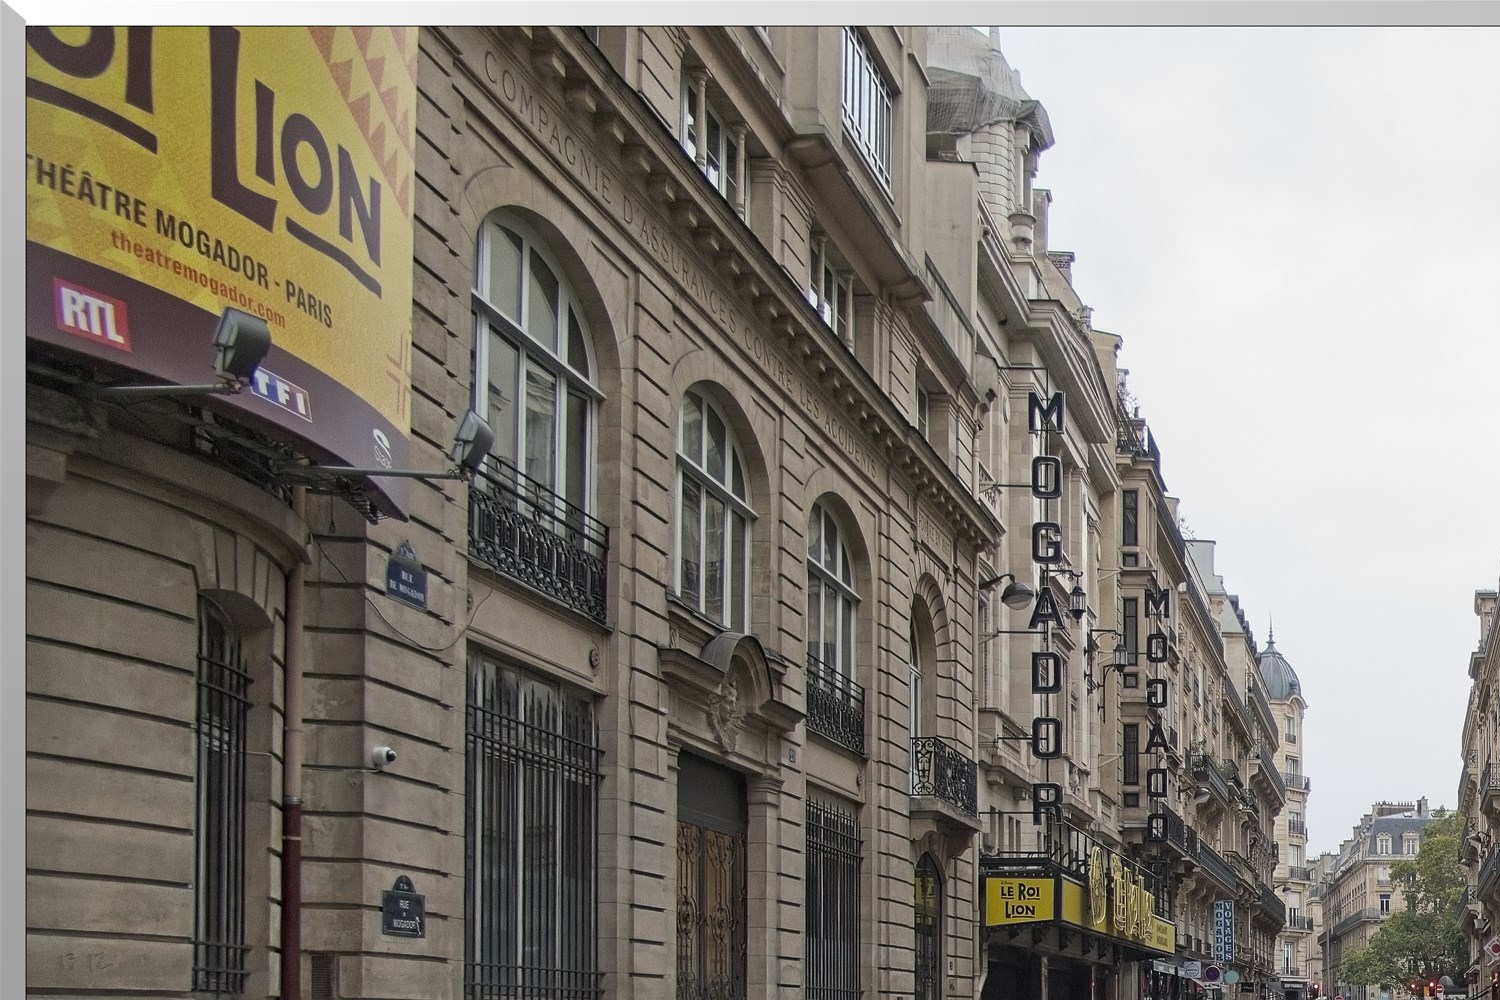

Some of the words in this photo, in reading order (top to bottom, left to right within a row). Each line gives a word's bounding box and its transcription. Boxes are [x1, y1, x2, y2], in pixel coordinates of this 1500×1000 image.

[209, 26, 382, 268] LION
[110, 230, 286, 329] theatremogador.com
[156, 207, 269, 290] MOGADOR
[286, 278, 332, 329] PARIS
[484, 51, 611, 205] COMPAGNIE
[744, 326, 793, 393] CONTRE
[824, 411, 878, 479] ACCIDENTS
[60, 286, 125, 344] RTL
[1027, 391, 1066, 826] MOGADOR
[1001, 886, 1014, 897] LE
[1018, 883, 1040, 901] ROI
[1005, 901, 1036, 919] LION
[1224, 902, 1232, 961] VOYAGES
[1214, 903, 1223, 961] MOGADOR
